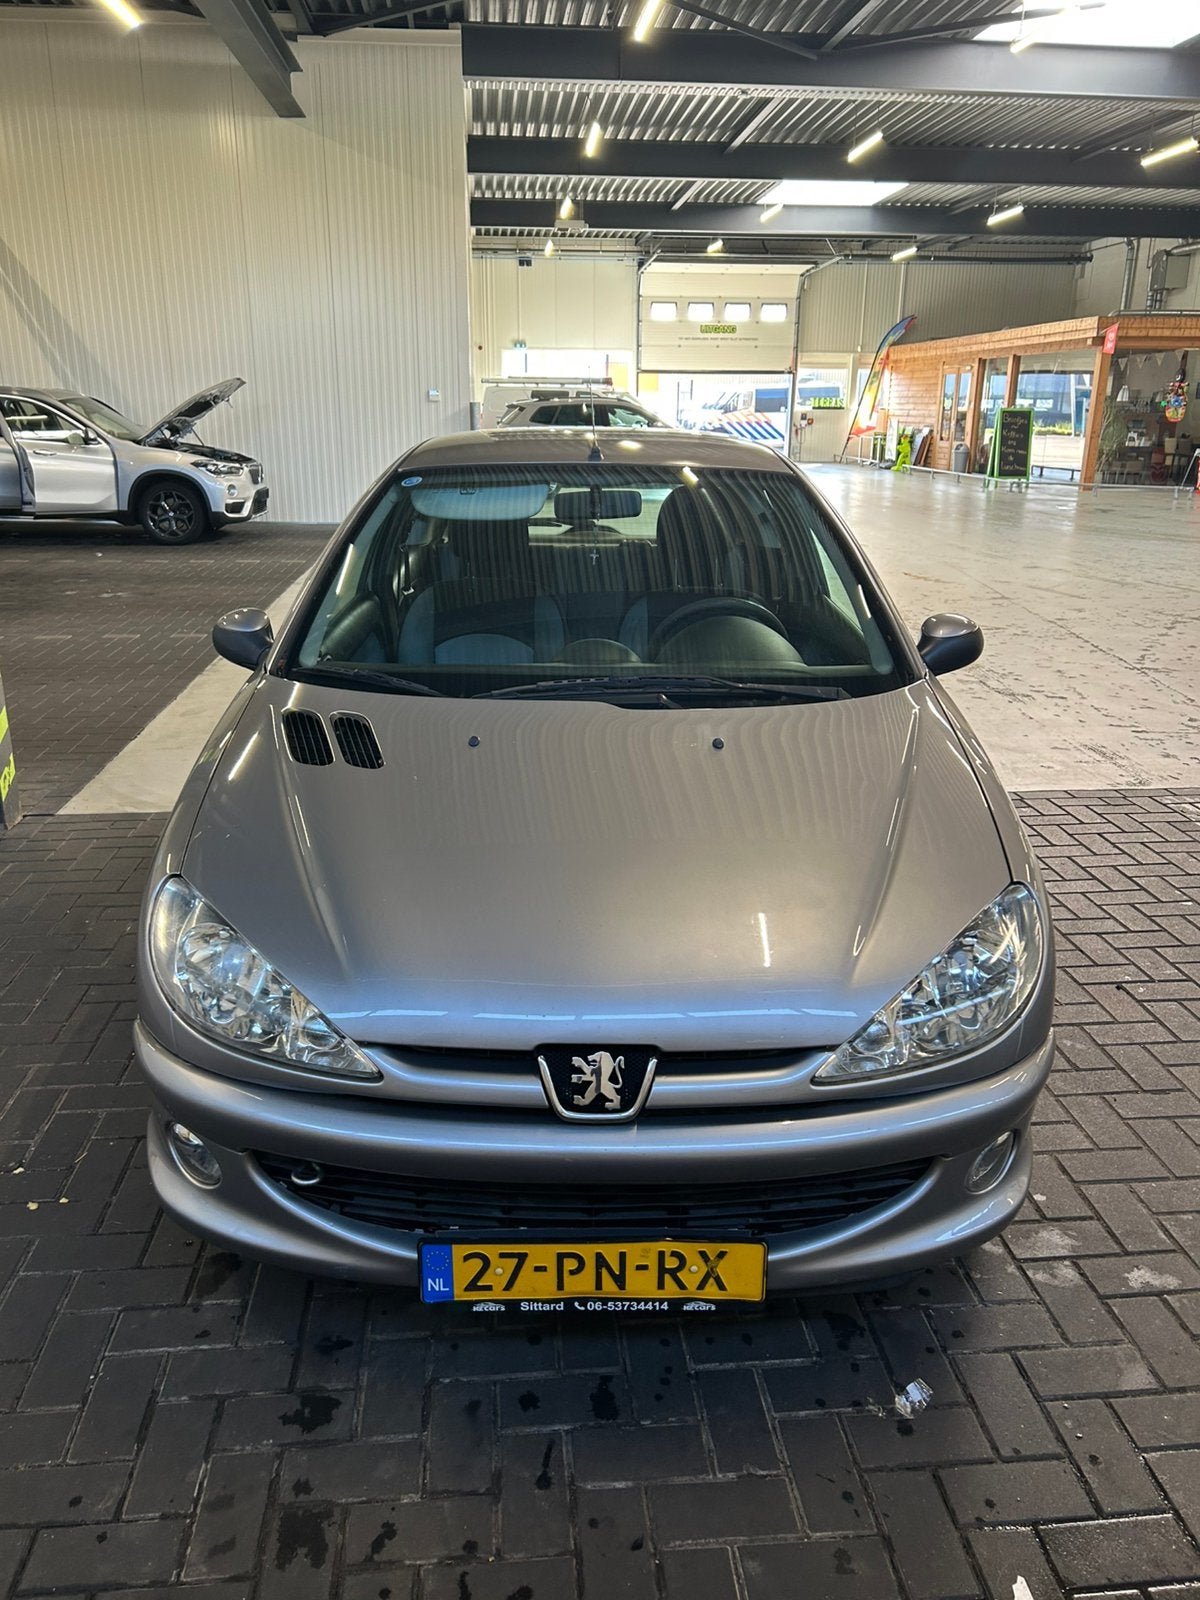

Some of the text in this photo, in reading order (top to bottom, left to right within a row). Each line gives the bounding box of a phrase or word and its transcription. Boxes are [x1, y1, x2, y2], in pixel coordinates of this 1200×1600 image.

[700, 324, 737, 334] UITGANG
[462, 1249, 729, 1292] 27-PN-RX
[427, 1278, 450, 1291] NL
[520, 1301, 564, 1311] Sittard
[587, 1301, 669, 1311] 06-53734414
